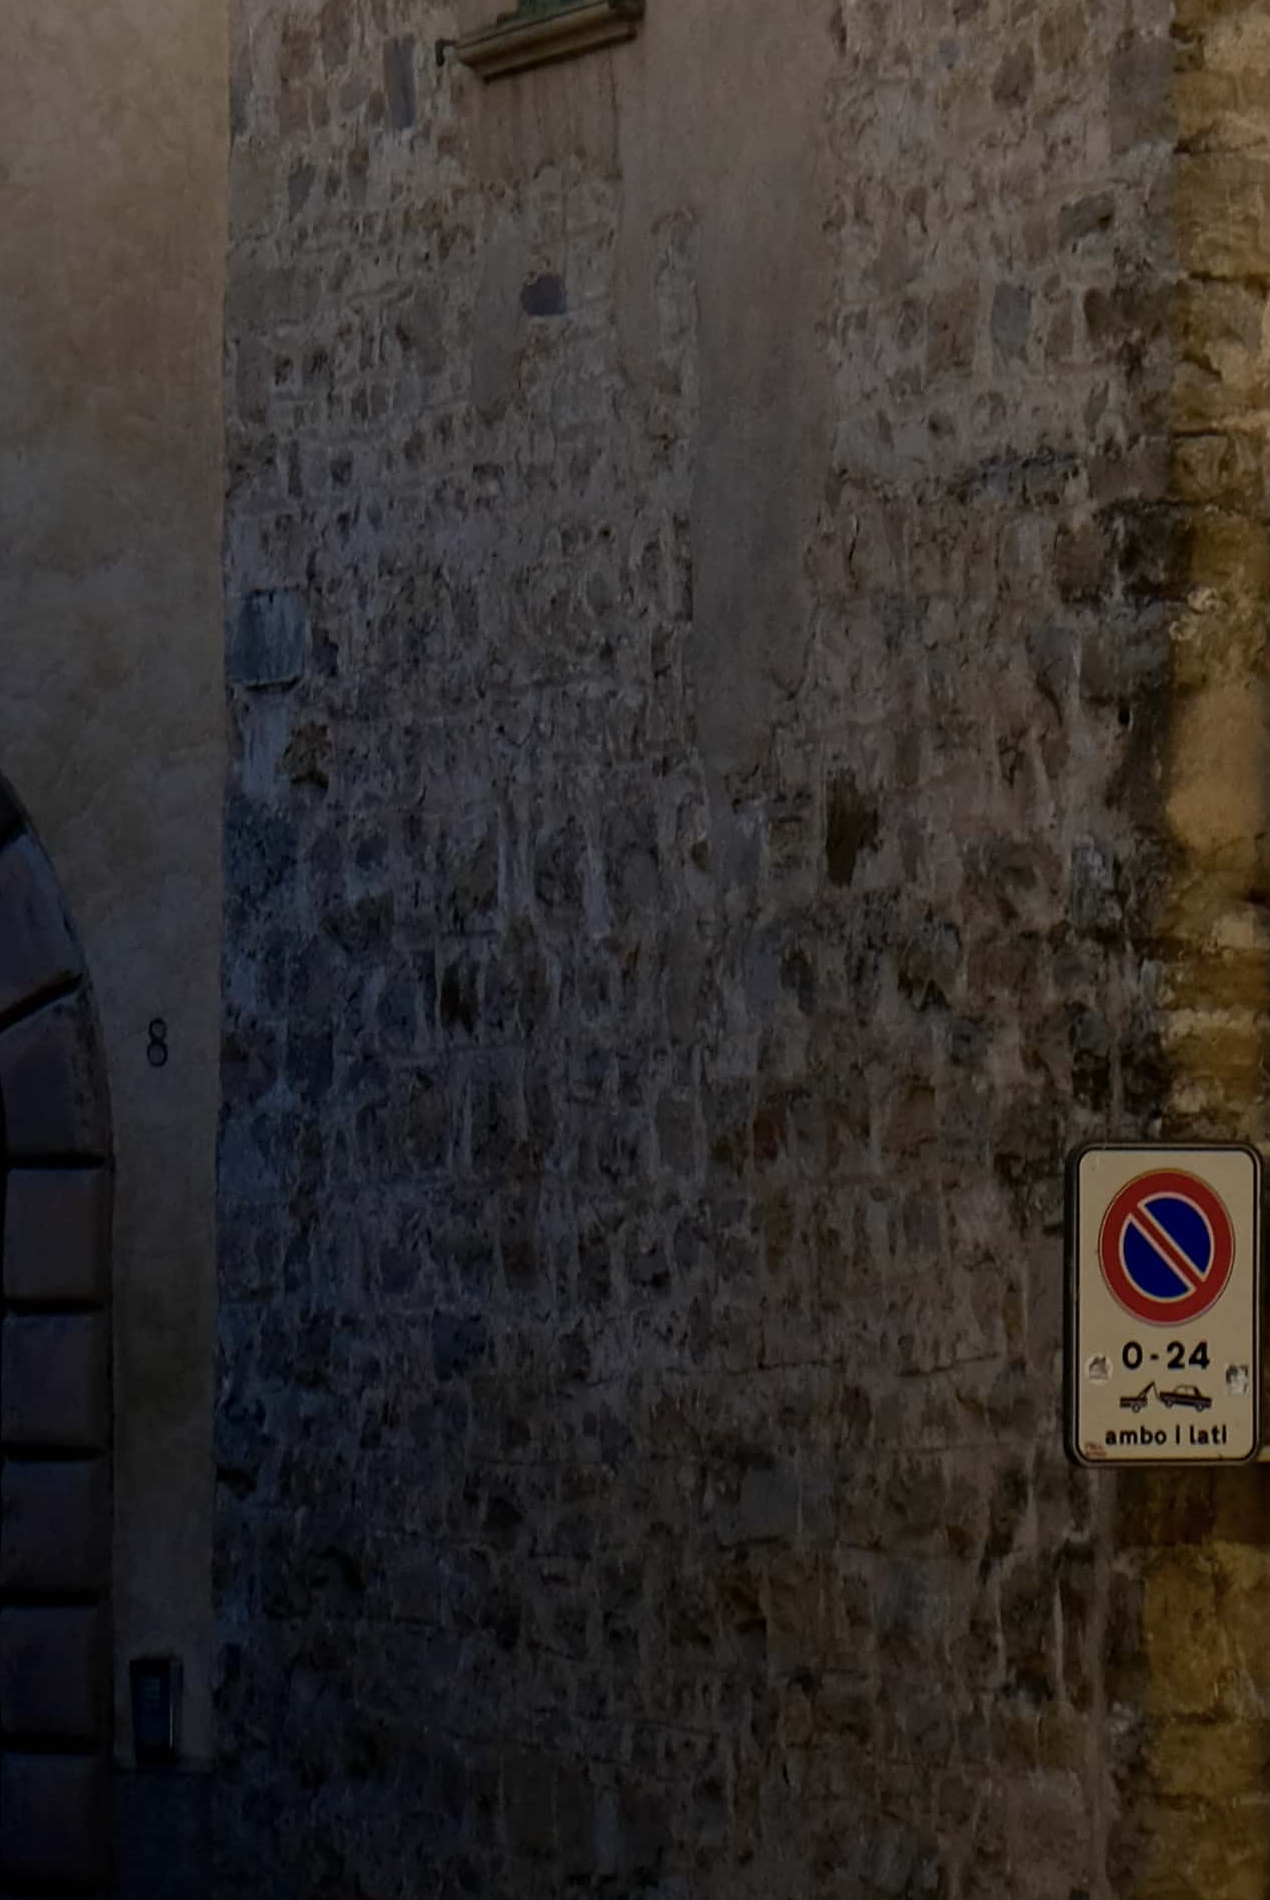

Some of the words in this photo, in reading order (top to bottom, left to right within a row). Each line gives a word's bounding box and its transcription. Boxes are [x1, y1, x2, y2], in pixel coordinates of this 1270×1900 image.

[147, 1018, 168, 1067] 8
[1105, 1425, 1167, 1445] ambo
[1190, 1423, 1227, 1445] lati
